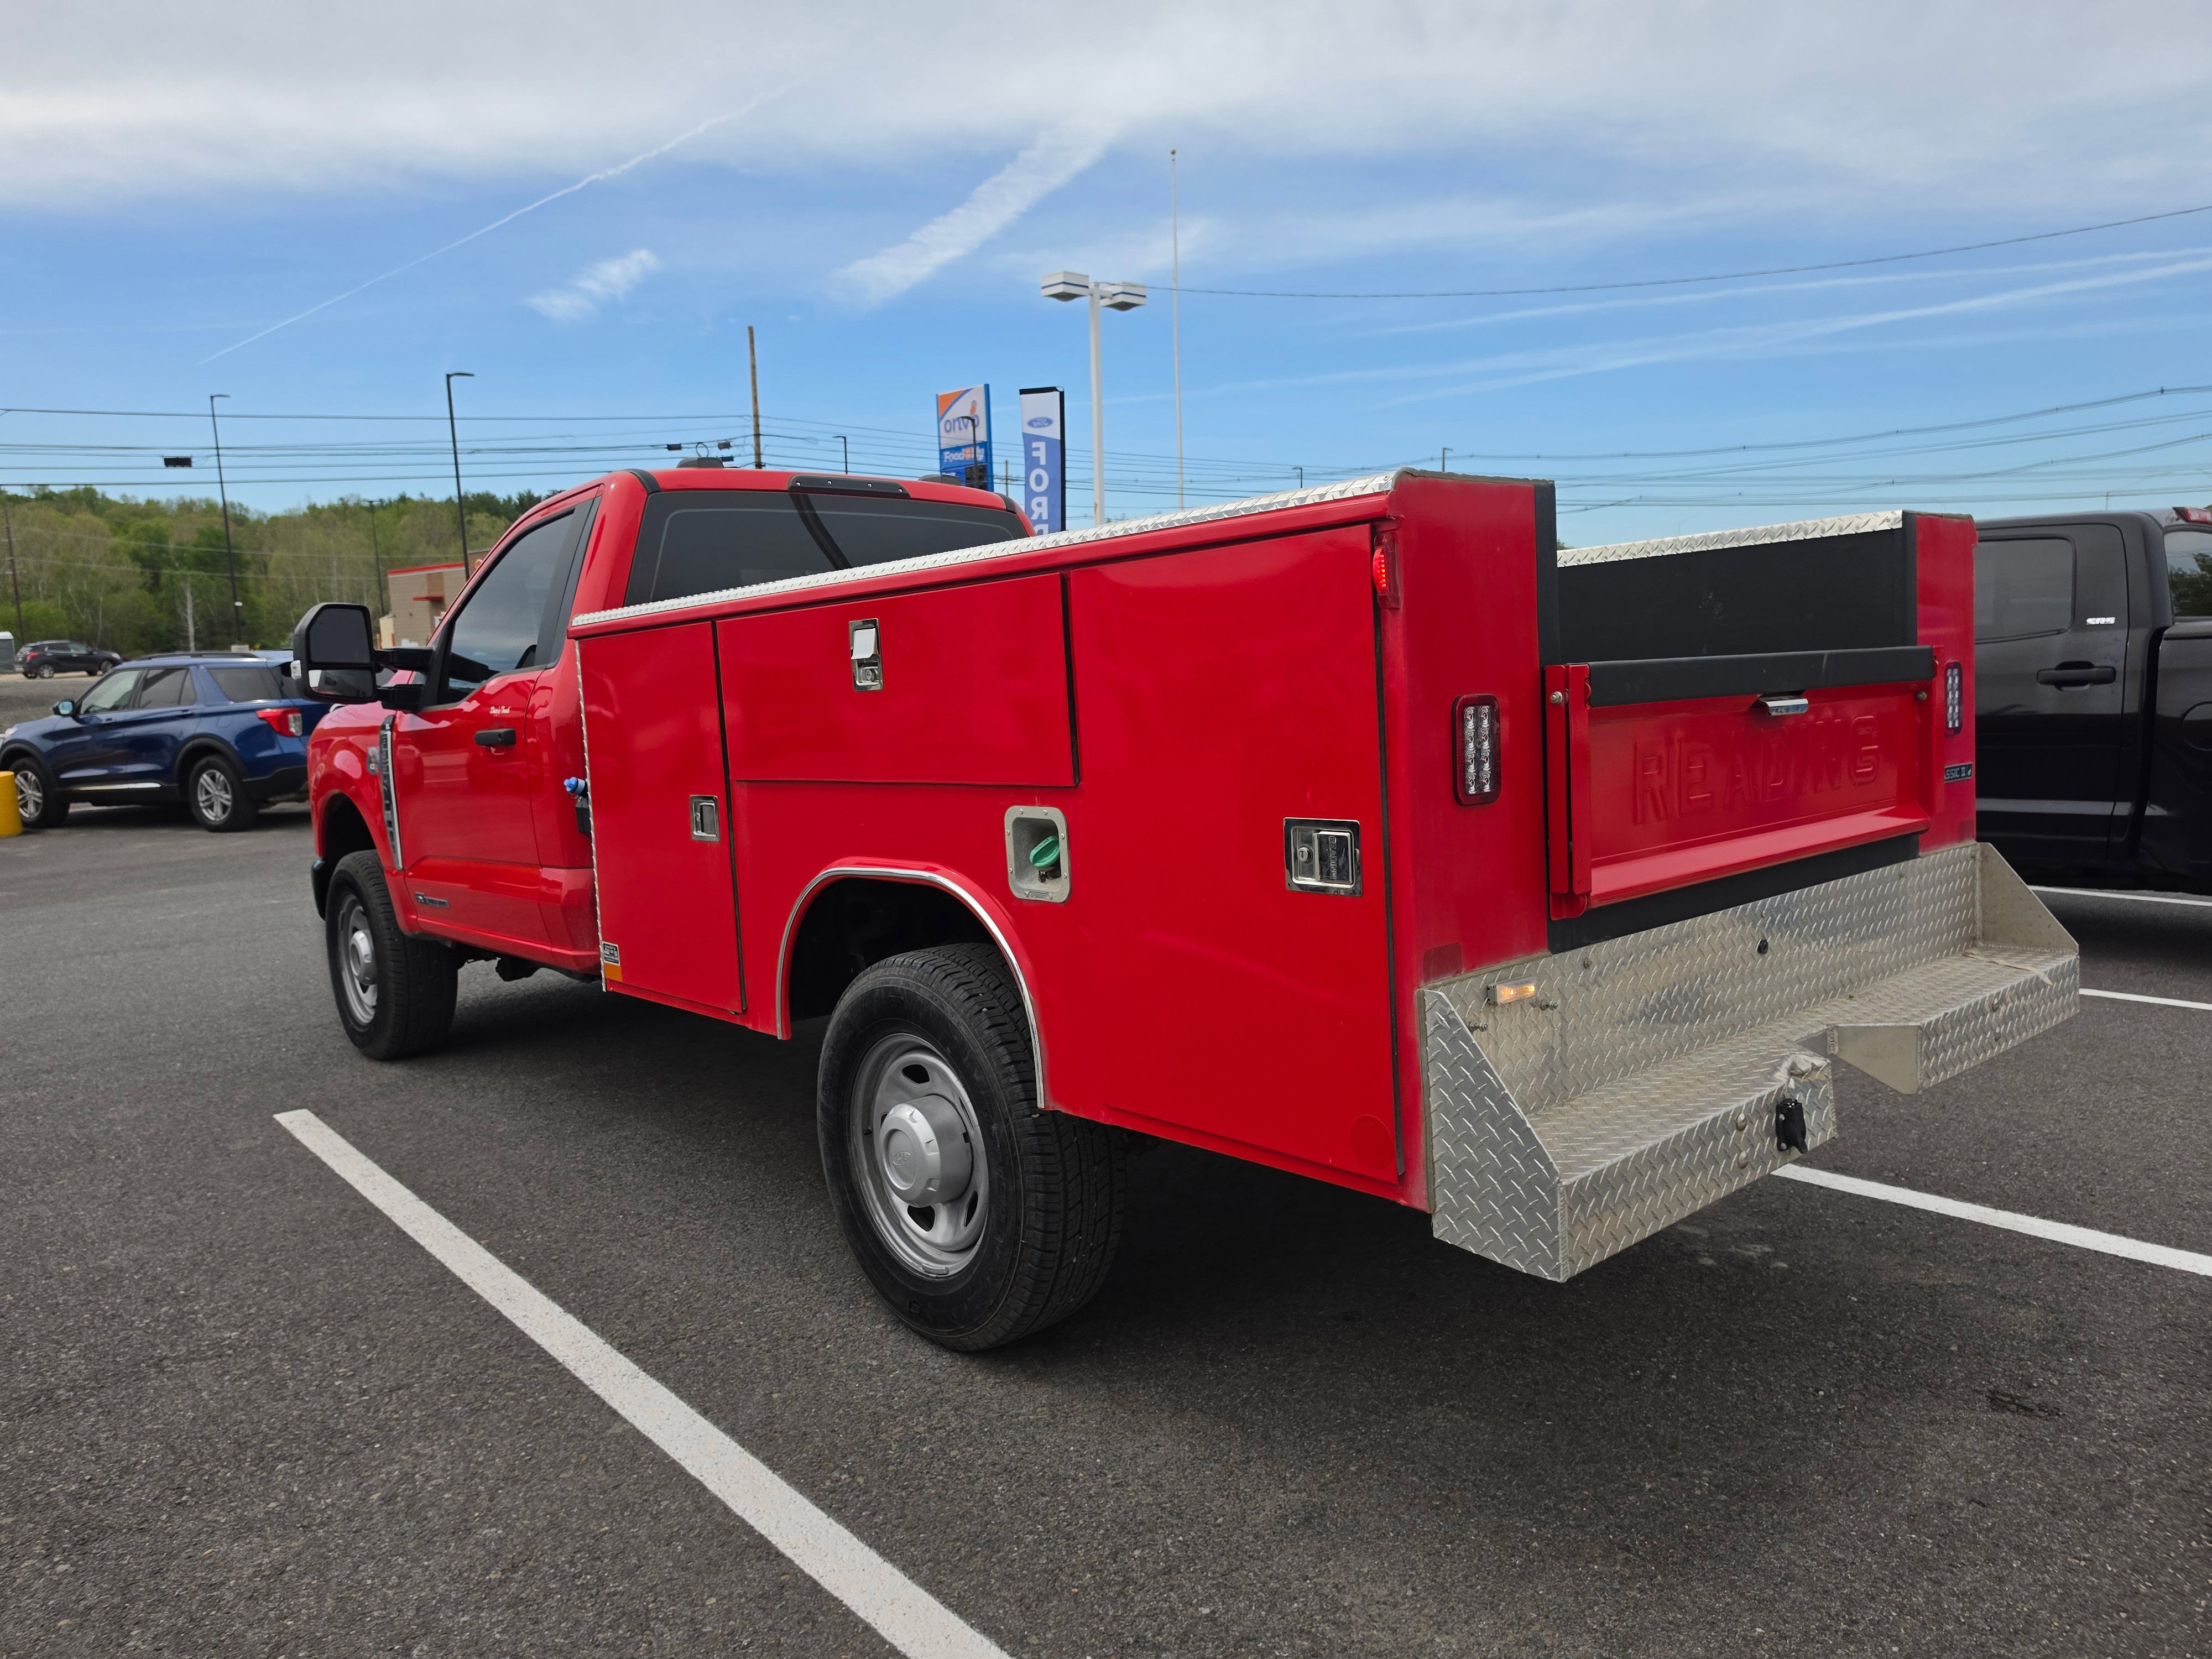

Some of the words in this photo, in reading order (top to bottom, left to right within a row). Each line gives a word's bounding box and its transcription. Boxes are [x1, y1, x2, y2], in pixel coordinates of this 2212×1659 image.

[1633, 716, 1879, 825] READING
[1945, 768, 1959, 779] SSIC
[1328, 836, 1338, 880] READING
